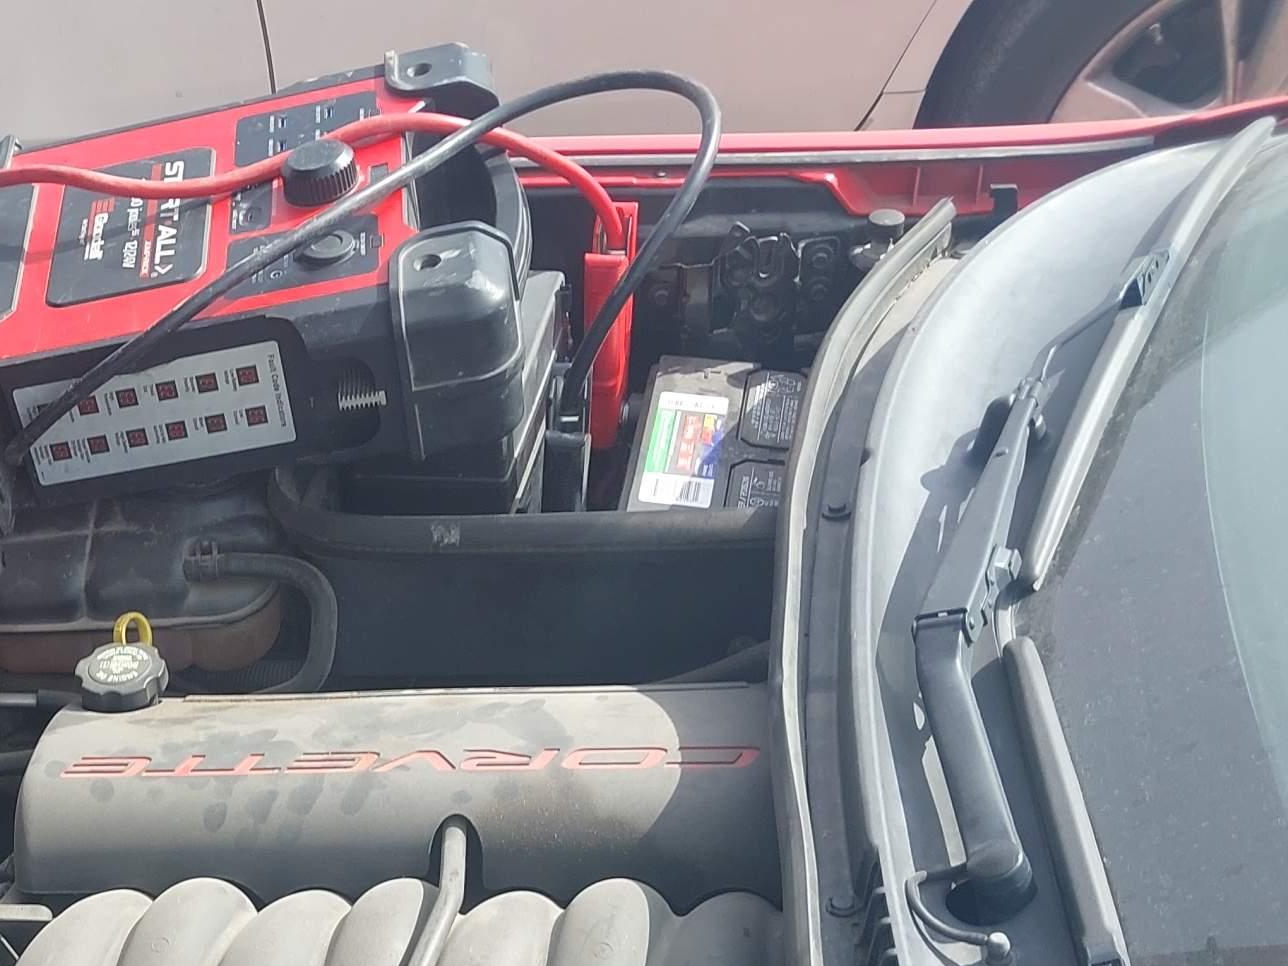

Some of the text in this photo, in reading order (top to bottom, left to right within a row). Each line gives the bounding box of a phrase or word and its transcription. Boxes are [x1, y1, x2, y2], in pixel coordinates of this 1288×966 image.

[154, 160, 185, 265] STRT ALL
[272, 374, 280, 391] Code
[59, 745, 760, 779] CORVETTE
